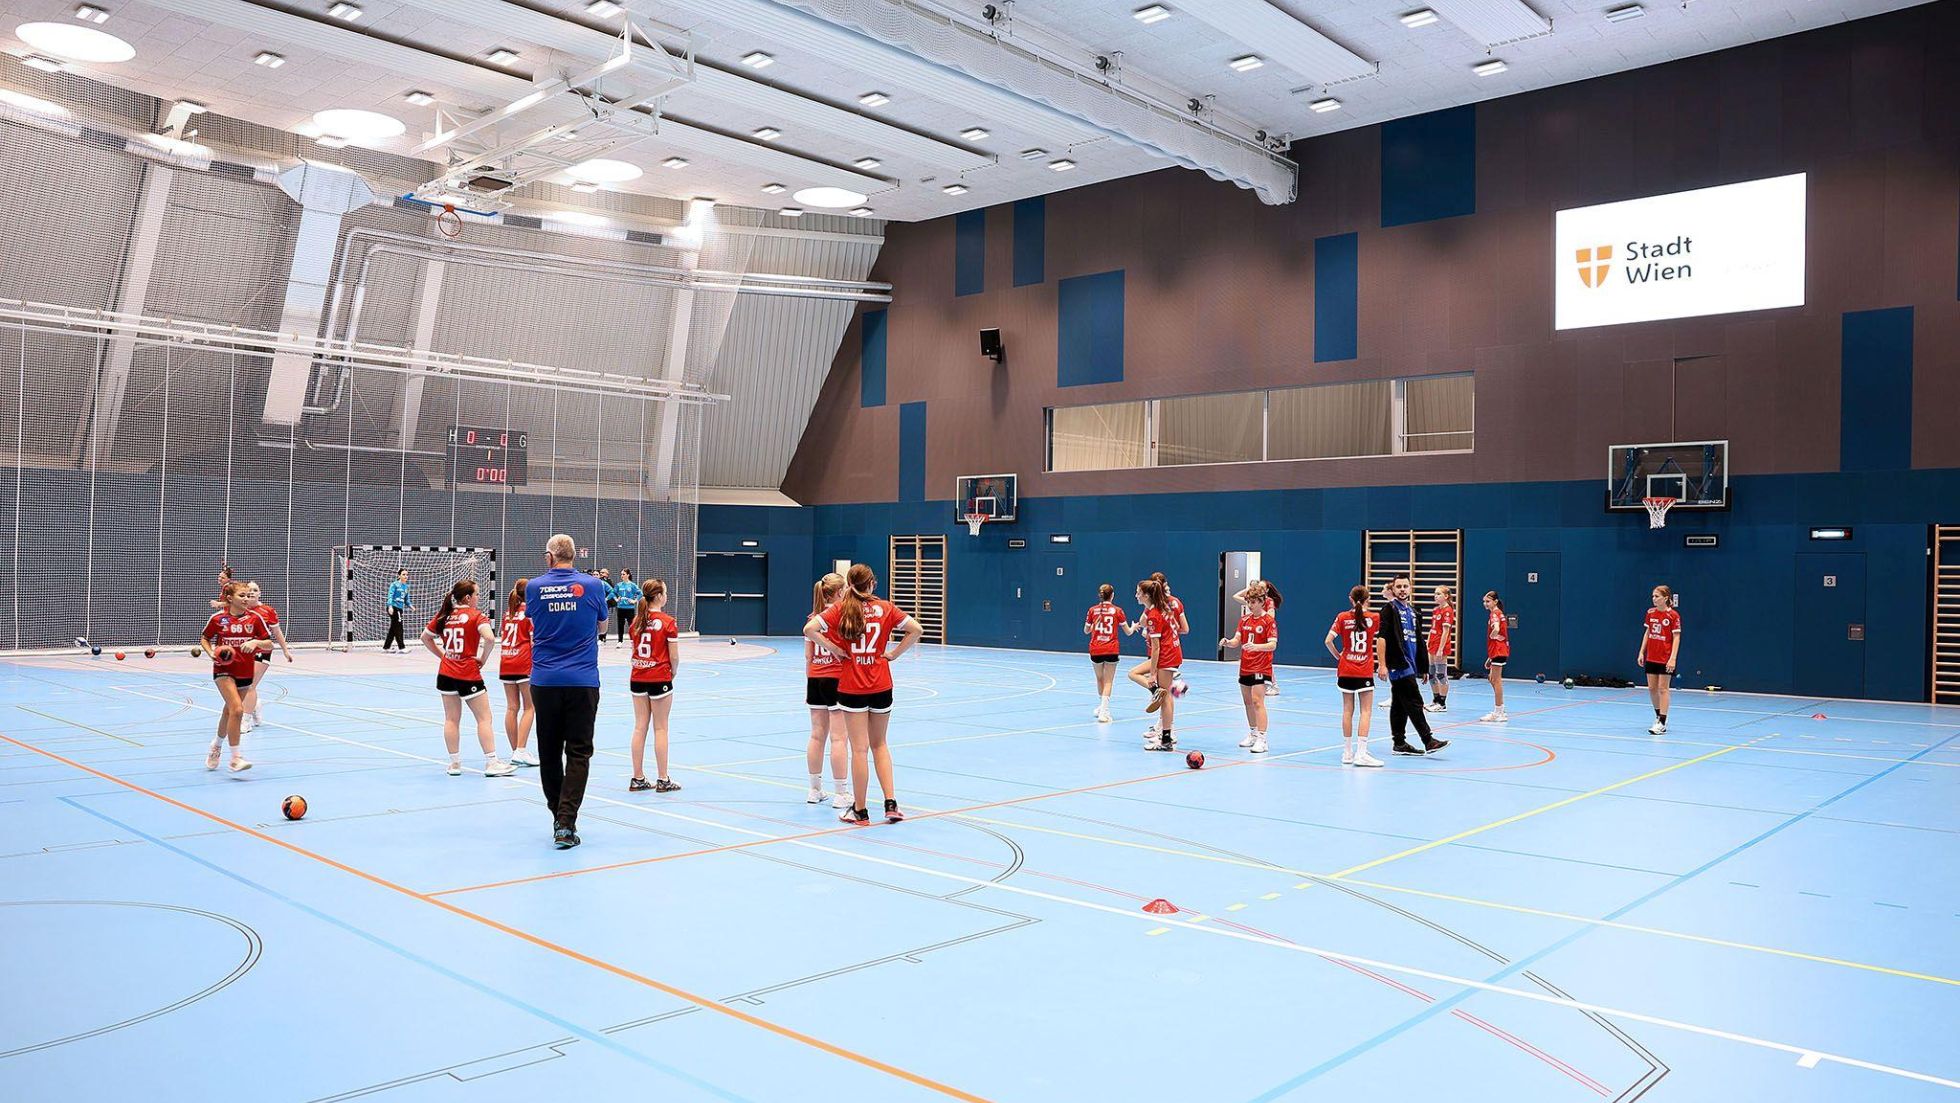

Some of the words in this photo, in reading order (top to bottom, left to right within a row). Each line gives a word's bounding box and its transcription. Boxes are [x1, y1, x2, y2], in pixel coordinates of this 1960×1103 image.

[1626, 236, 1692, 261] Stadt
[1626, 263, 1692, 284] Wien
[519, 435, 526, 448] G
[548, 602, 577, 612] COACH
[230, 624, 243, 633] 66
[502, 623, 518, 647] 21
[1094, 616, 1114, 634] 43
[443, 627, 464, 653] 26
[638, 633, 652, 658] 6
[1349, 630, 1368, 653] 18
